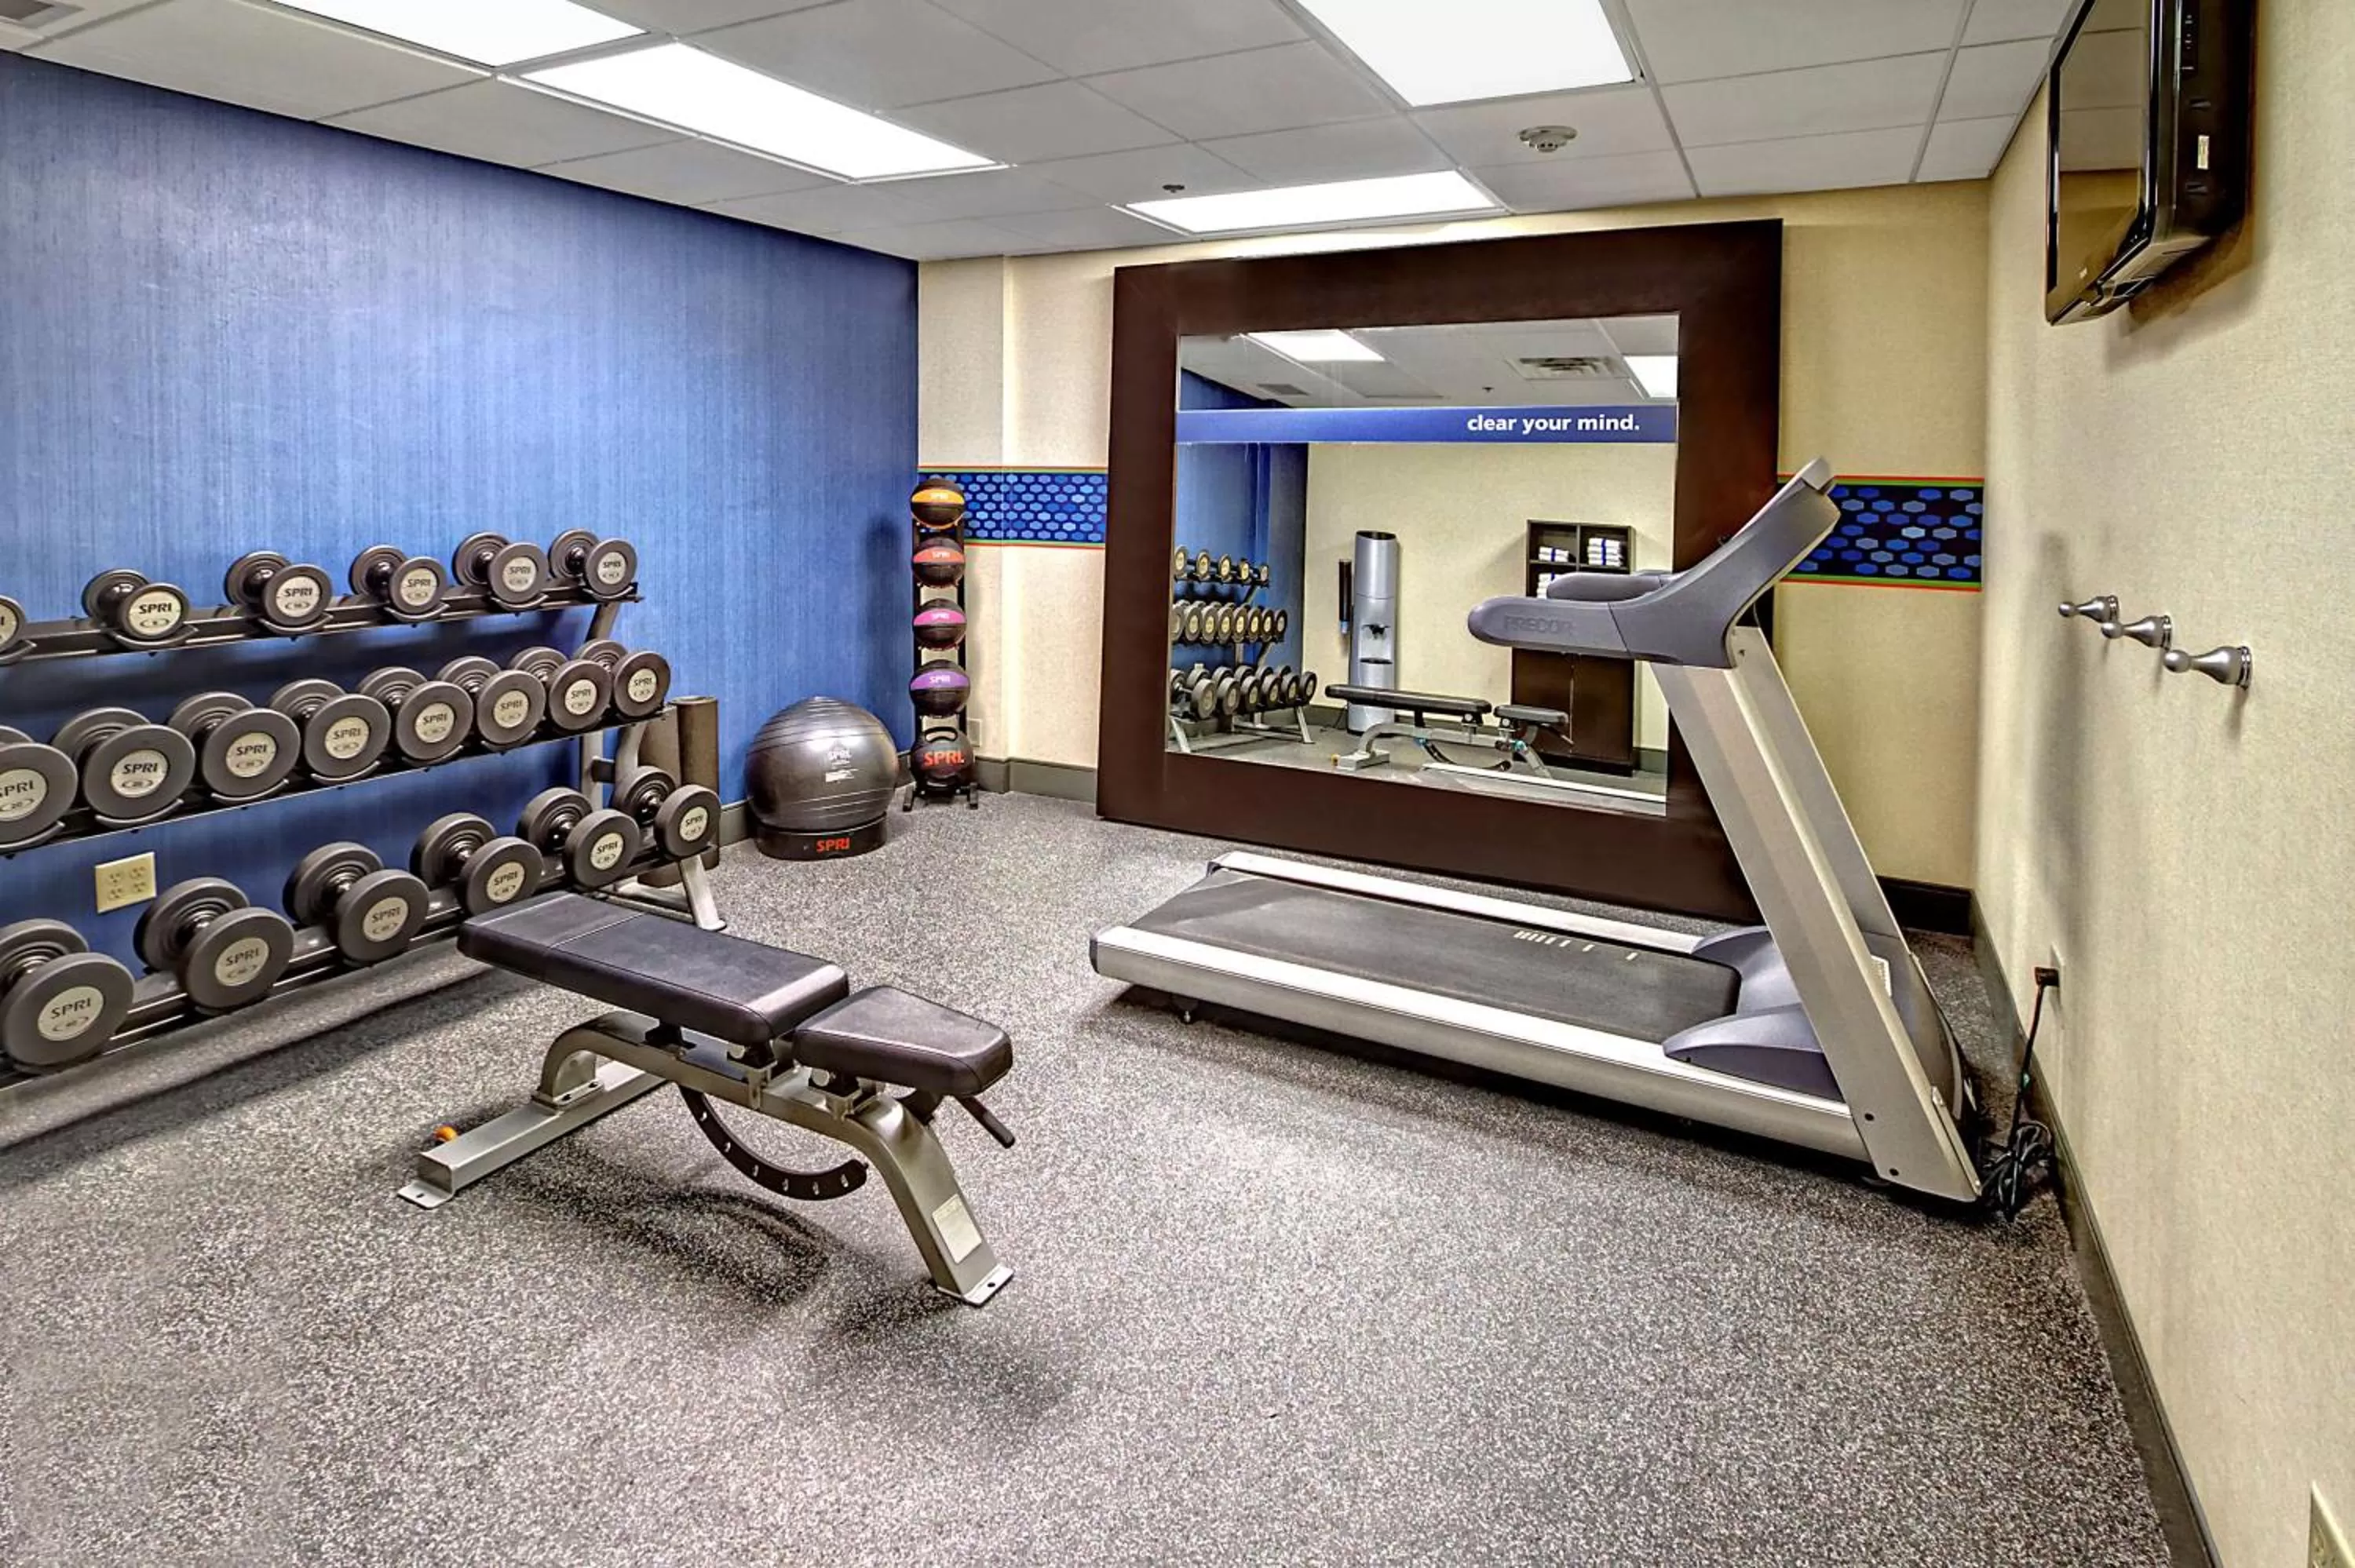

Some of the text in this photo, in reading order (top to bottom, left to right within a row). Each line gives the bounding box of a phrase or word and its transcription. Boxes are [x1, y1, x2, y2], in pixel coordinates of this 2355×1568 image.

[1467, 414, 1639, 434] clear your mind.
[509, 566, 531, 574] SPRI
[408, 578, 431, 588] SPRI
[284, 587, 312, 597] SPRI
[139, 602, 172, 614] SPRI
[634, 677, 652, 686] SPRI
[571, 688, 591, 698] SPRI
[500, 700, 524, 711] SPRI
[423, 713, 447, 725] SPRI
[333, 727, 361, 739] SPRI
[236, 744, 268, 756] SPRI
[924, 750, 963, 766] SPRI
[122, 762, 159, 775] SPRI
[685, 815, 704, 827] SPRI
[597, 841, 618, 854] SPRI
[816, 837, 850, 854] SPRI
[494, 871, 518, 885] SPRI
[372, 906, 400, 923] SPRI
[225, 947, 260, 966] SPRI
[50, 997, 91, 1019] SPRI
